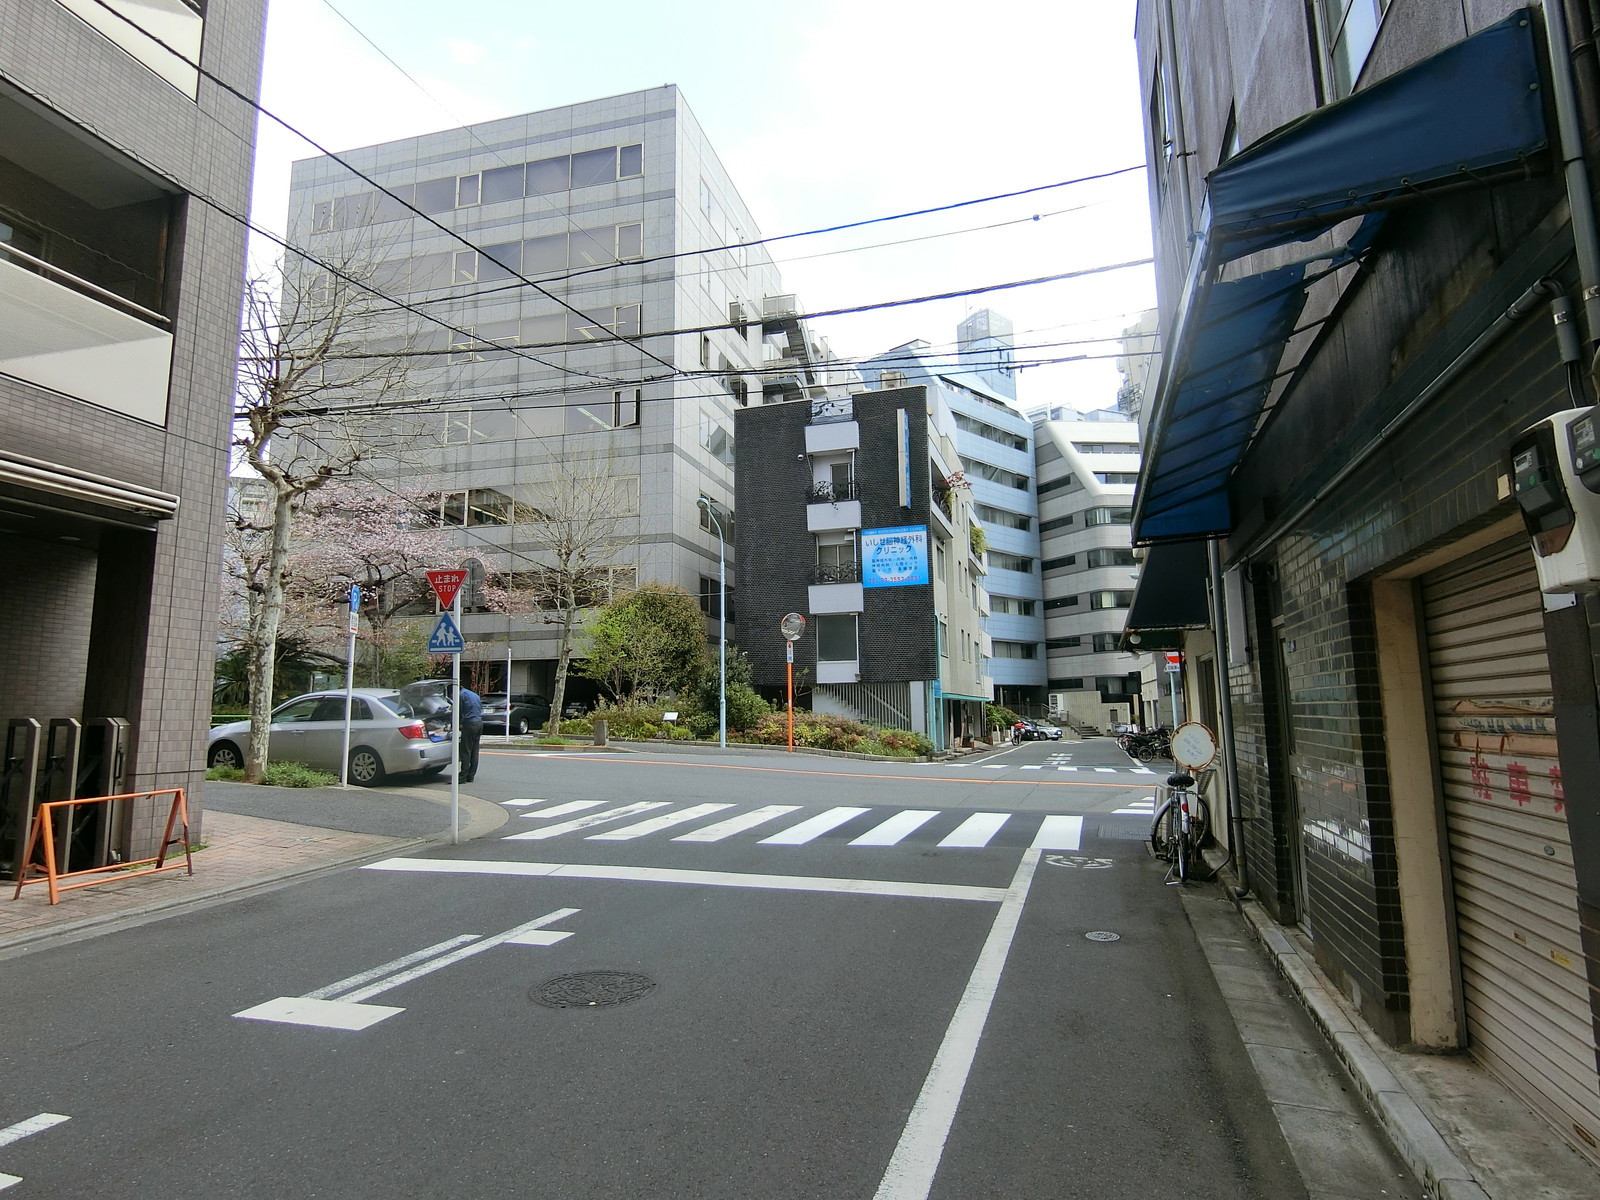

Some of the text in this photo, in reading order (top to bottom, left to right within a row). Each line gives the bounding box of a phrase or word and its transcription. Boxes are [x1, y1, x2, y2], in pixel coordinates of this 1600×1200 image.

[876, 545, 912, 555] クリニック
[435, 574, 460, 584] 止まれ
[438, 585, 457, 593] STOP
